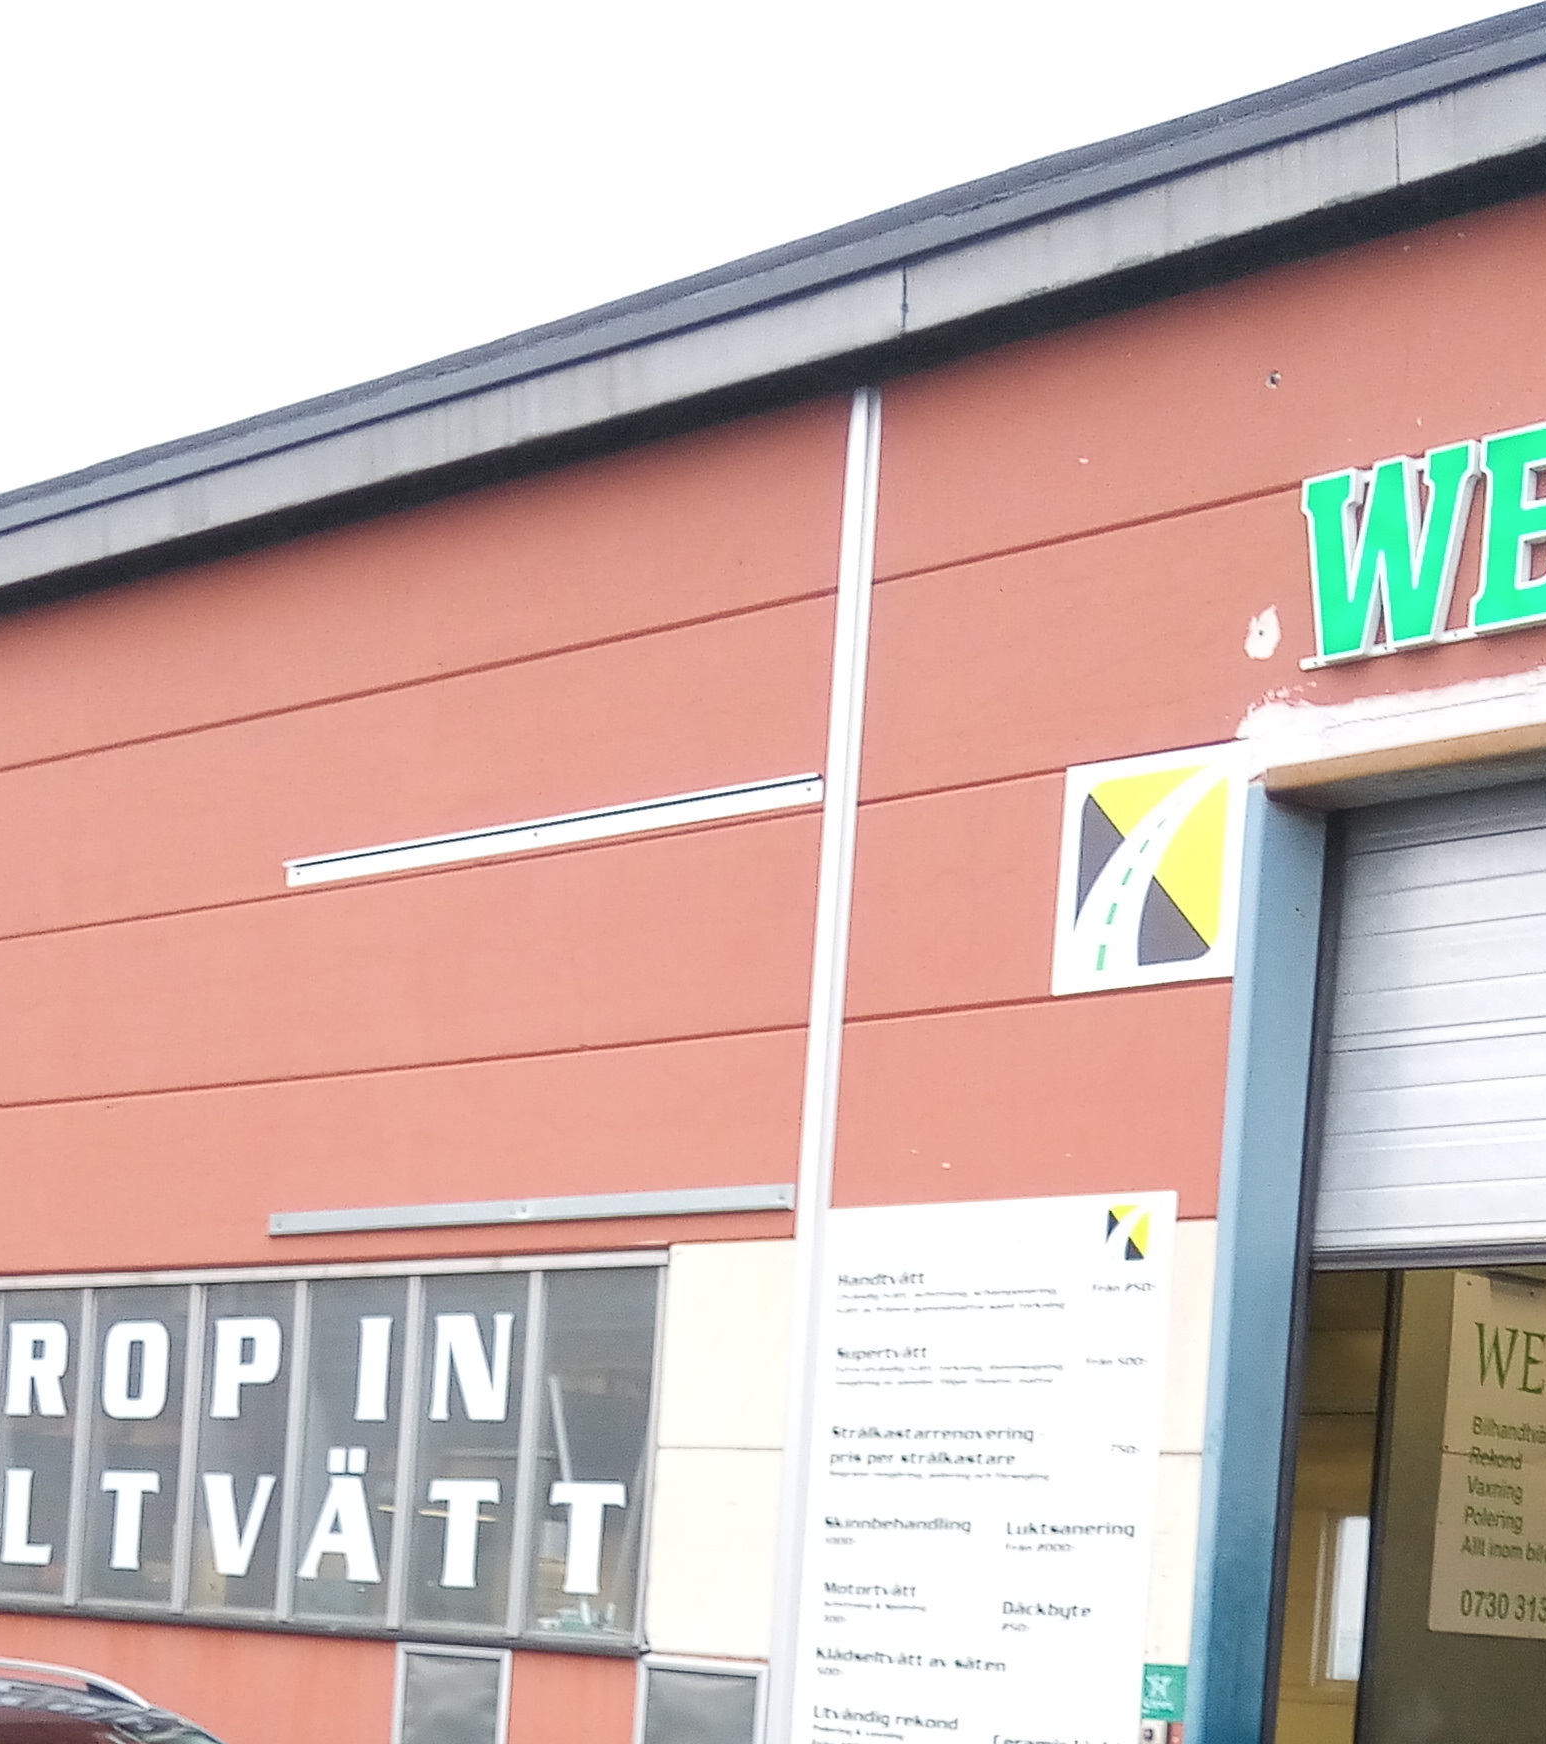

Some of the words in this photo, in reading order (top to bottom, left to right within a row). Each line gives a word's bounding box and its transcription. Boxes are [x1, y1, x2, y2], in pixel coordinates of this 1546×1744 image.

[838, 1272, 925, 1287] Handtvätt
[836, 1346, 927, 1362] Supertvätt
[1474, 1321, 1546, 1396] WE
[353, 1310, 516, 1424] IN
[831, 1424, 1034, 1443] Strålkastarrenovering
[829, 1451, 862, 1466] pris
[867, 1454, 894, 1467] per
[900, 1451, 1016, 1466] strålkastare
[1470, 1446, 1523, 1470] Rekond
[1467, 1475, 1523, 1505] Vaxning
[824, 1515, 972, 1534] Skinnbehandling
[1006, 1520, 1136, 1538] Luktsanering
[1464, 1506, 1523, 1535] Polering
[1461, 1535, 1486, 1557] Allt
[1489, 1539, 1523, 1561] inom
[823, 1581, 916, 1598] Motortvätt
[1002, 1600, 1092, 1621] Däckbyte
[1460, 1590, 1509, 1620] 0730
[815, 1646, 923, 1667] Klädseltvätt
[929, 1657, 947, 1668] av
[953, 1657, 1007, 1673] säten
[813, 1704, 890, 1728] Utvändig
[895, 1713, 959, 1731] rekond
